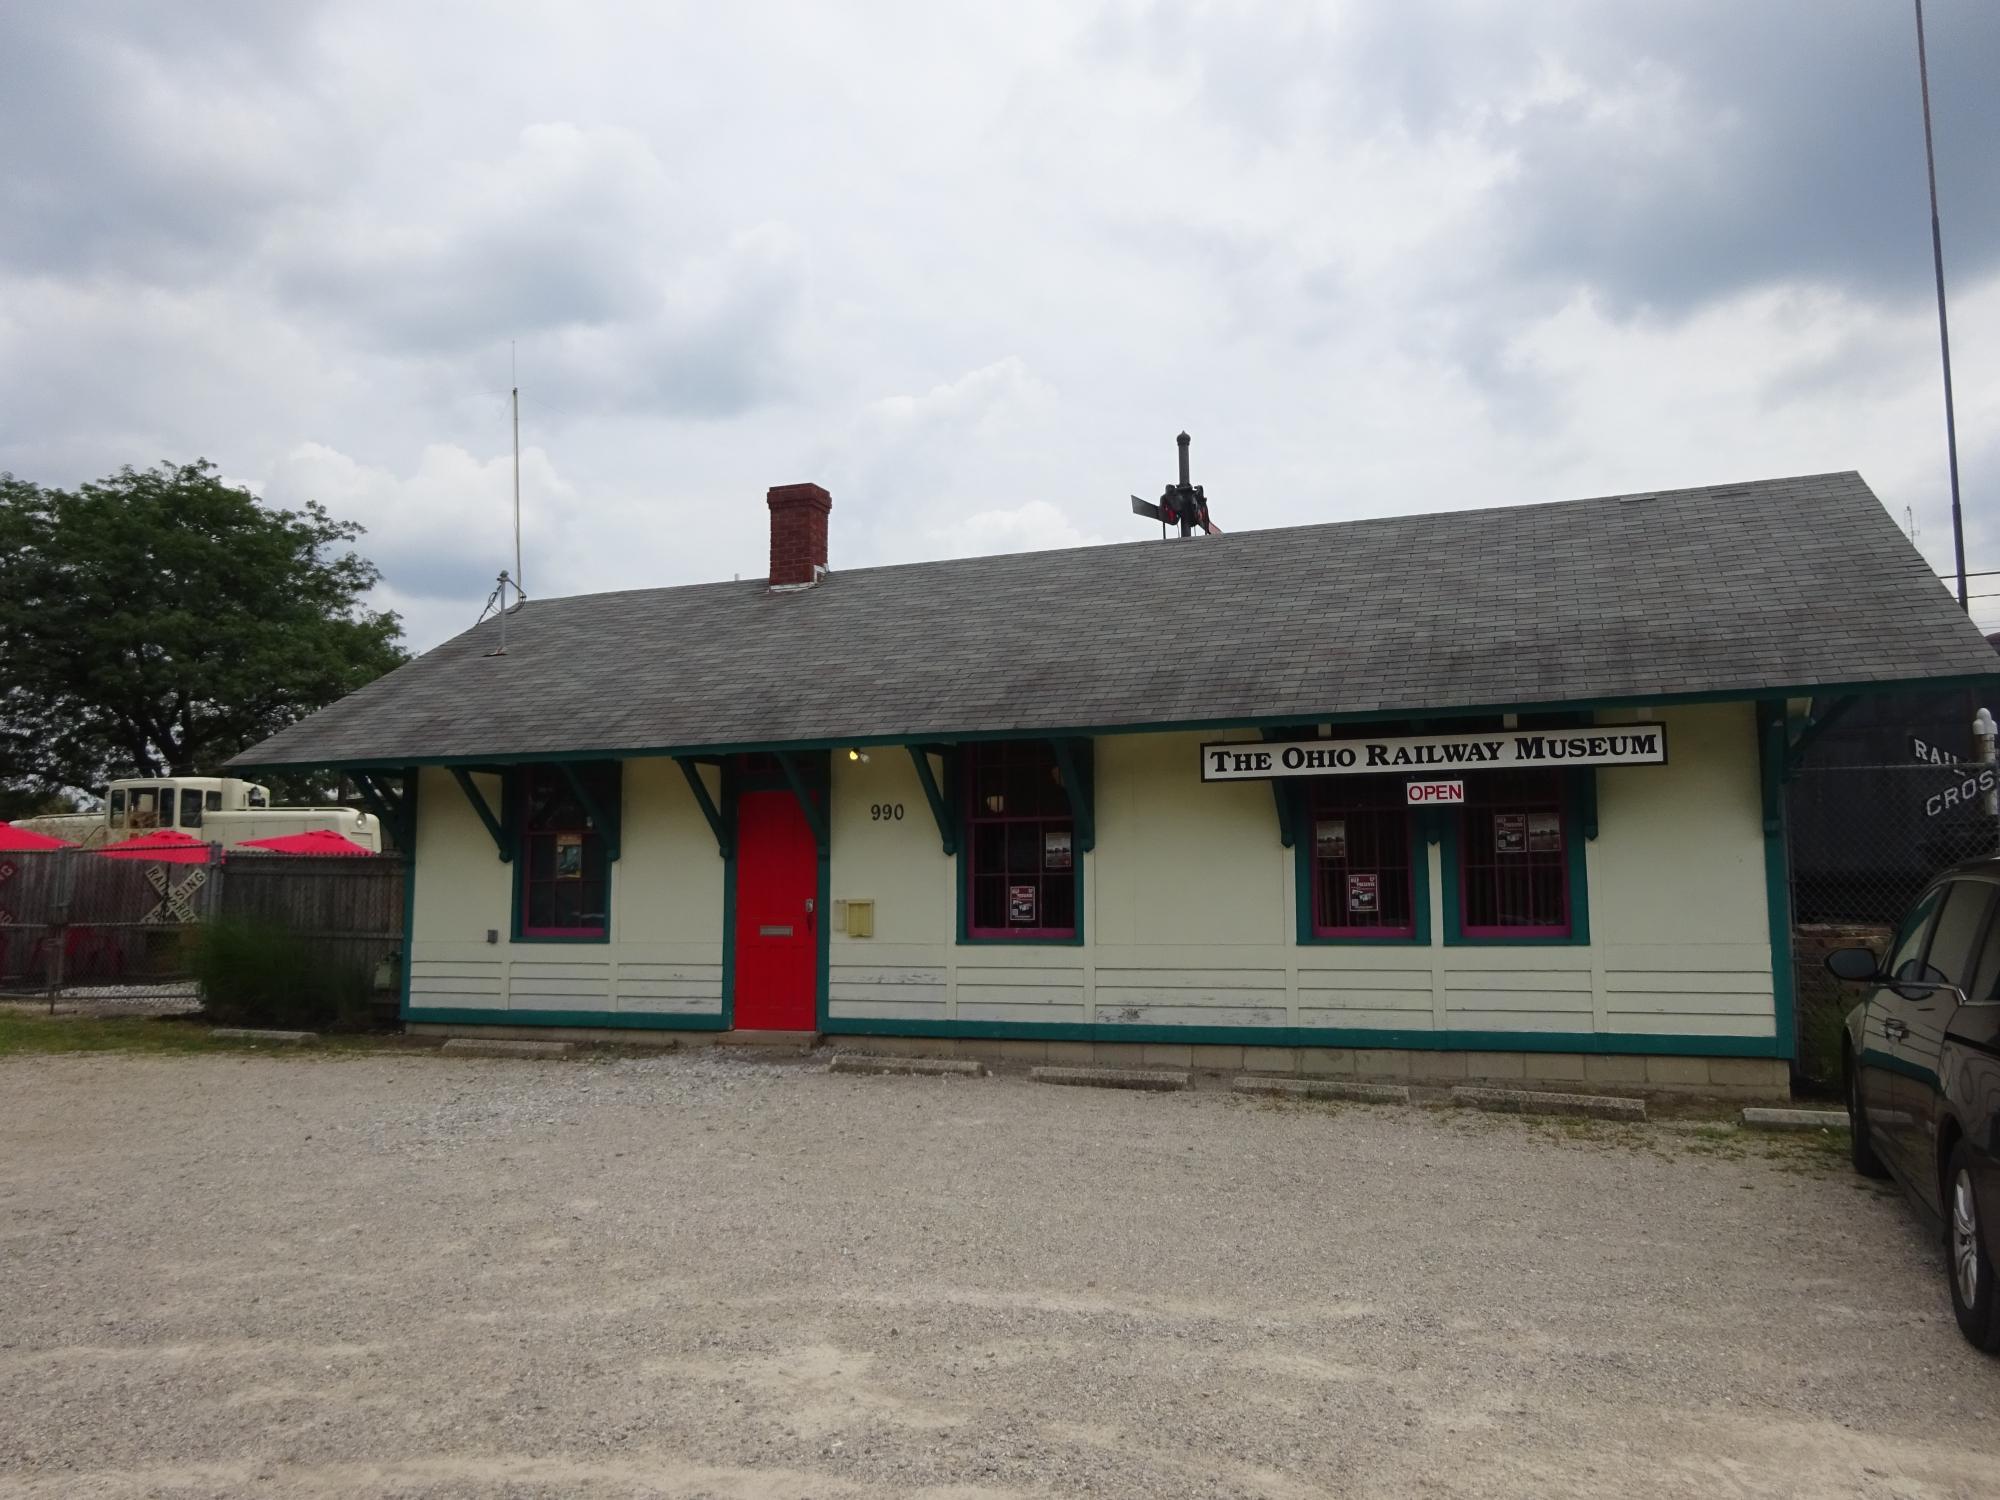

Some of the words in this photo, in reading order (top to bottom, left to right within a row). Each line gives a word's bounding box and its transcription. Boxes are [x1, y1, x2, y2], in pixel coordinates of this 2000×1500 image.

[1210, 750, 1273, 773] THE
[1282, 746, 1357, 770] OHIO
[1365, 742, 1505, 766] RAILWAY
[1516, 734, 1658, 760] MUSEUM
[1409, 784, 1463, 802] OPEN
[1926, 769, 2000, 817] CROS
[870, 803, 905, 821] 990
